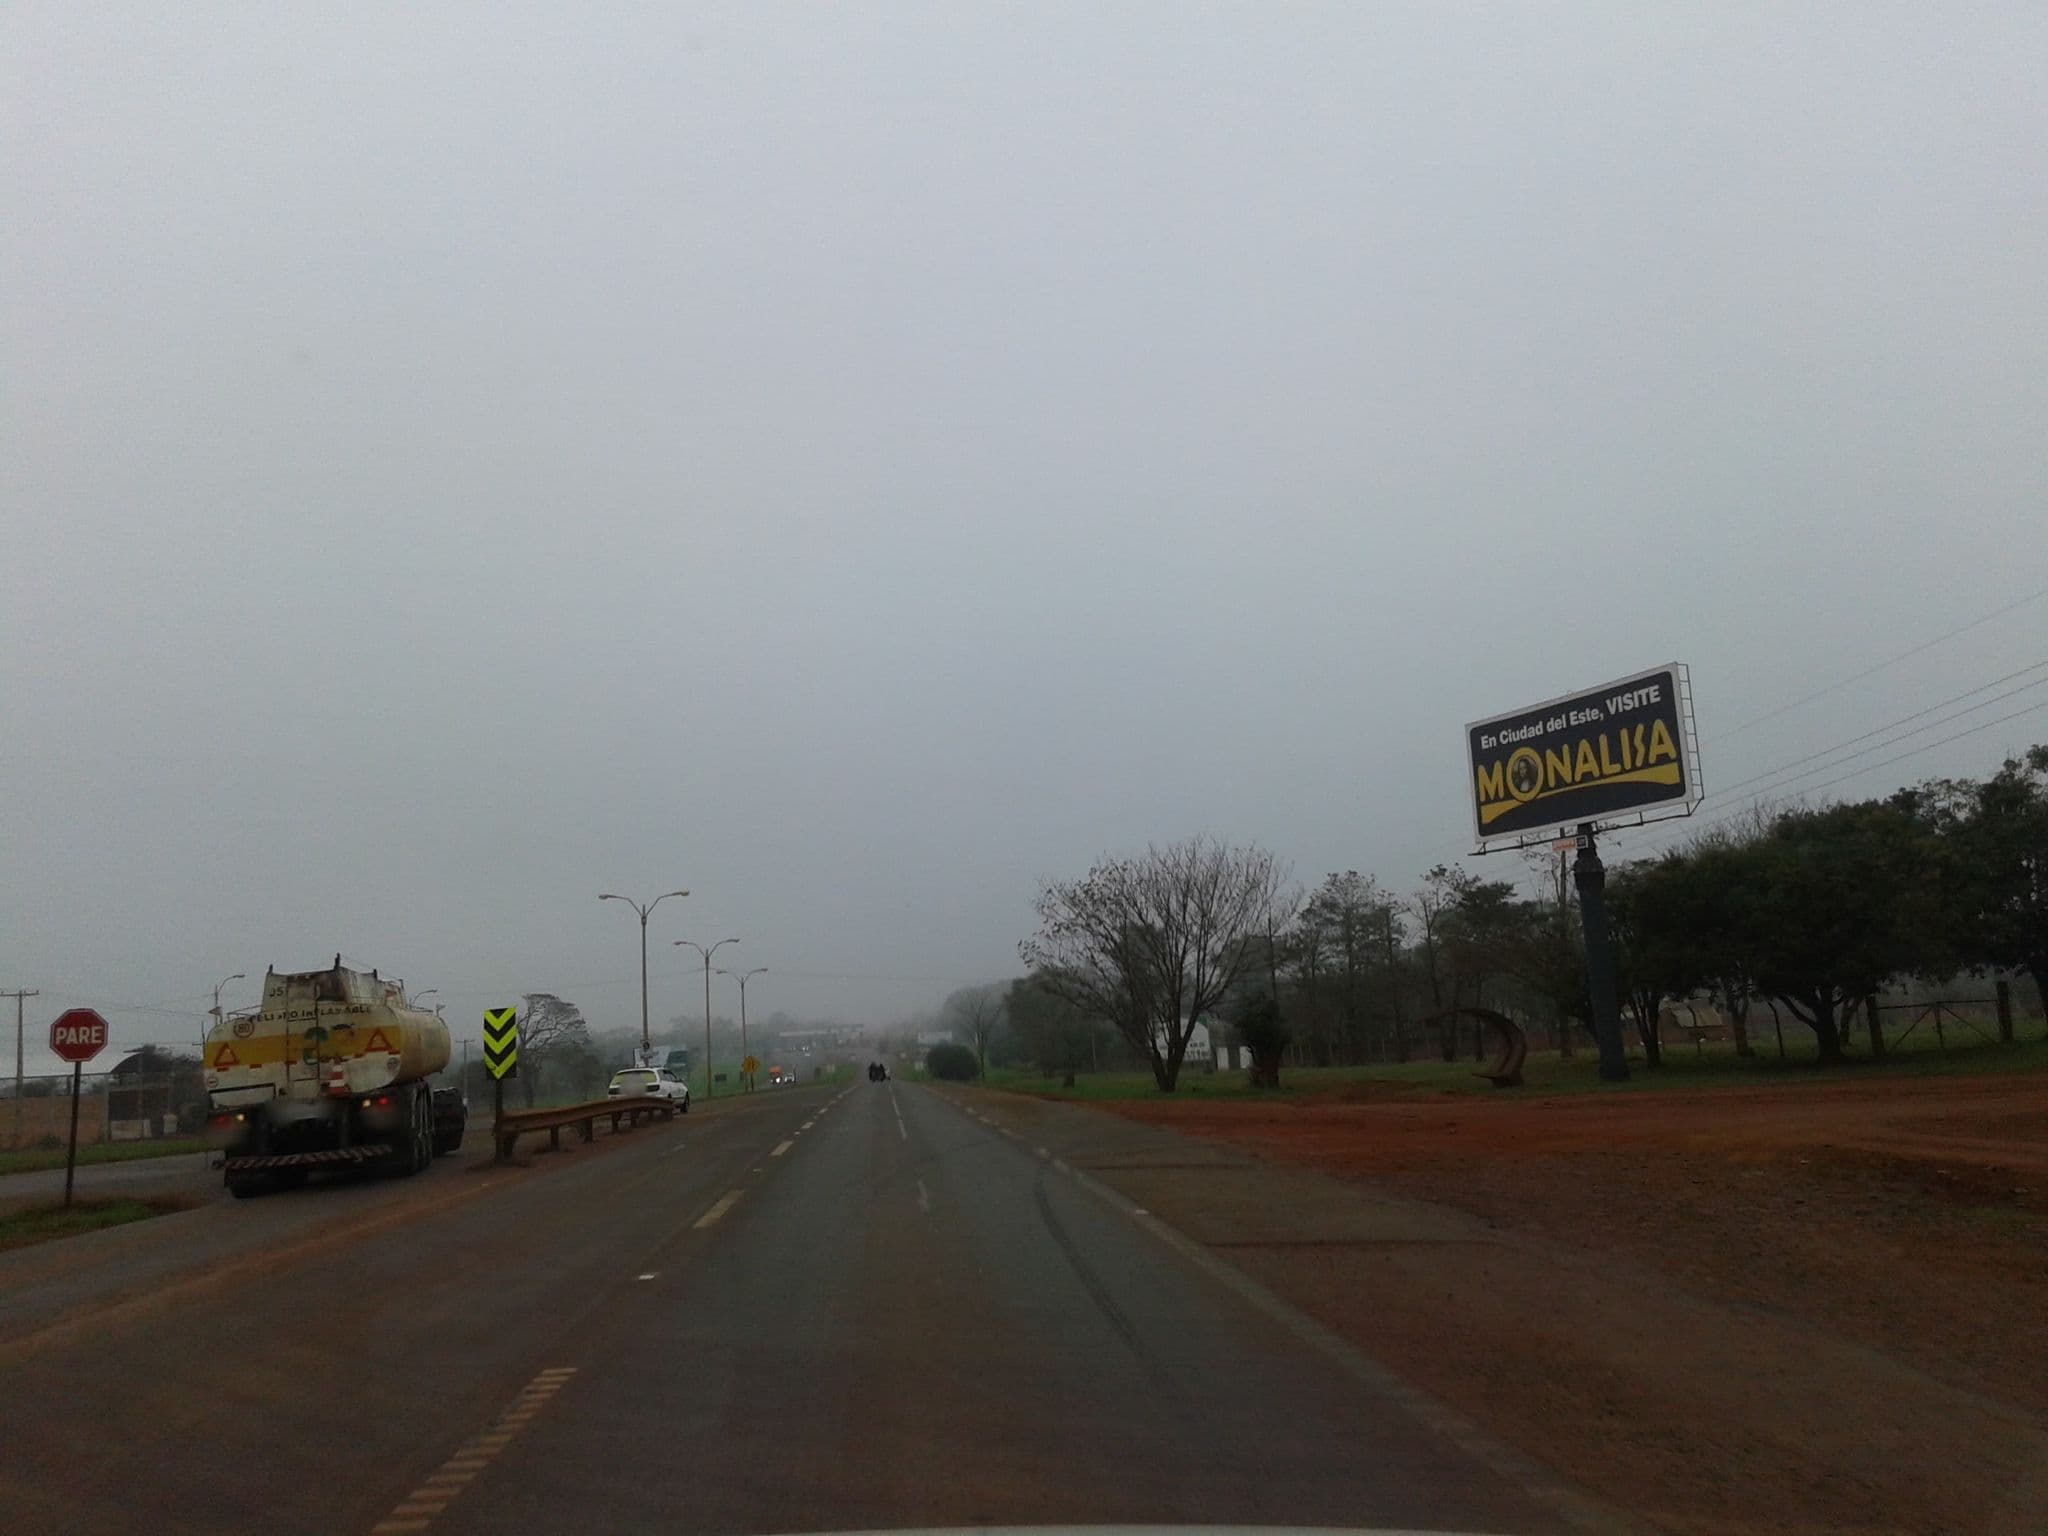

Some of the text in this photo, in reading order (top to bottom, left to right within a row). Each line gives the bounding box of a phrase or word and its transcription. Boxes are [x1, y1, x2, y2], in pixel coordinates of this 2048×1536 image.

[1481, 685, 1661, 750] En Ciudad del Este, VISITE
[1477, 719, 1677, 803] MONALISA
[55, 1025, 104, 1045] PARE
